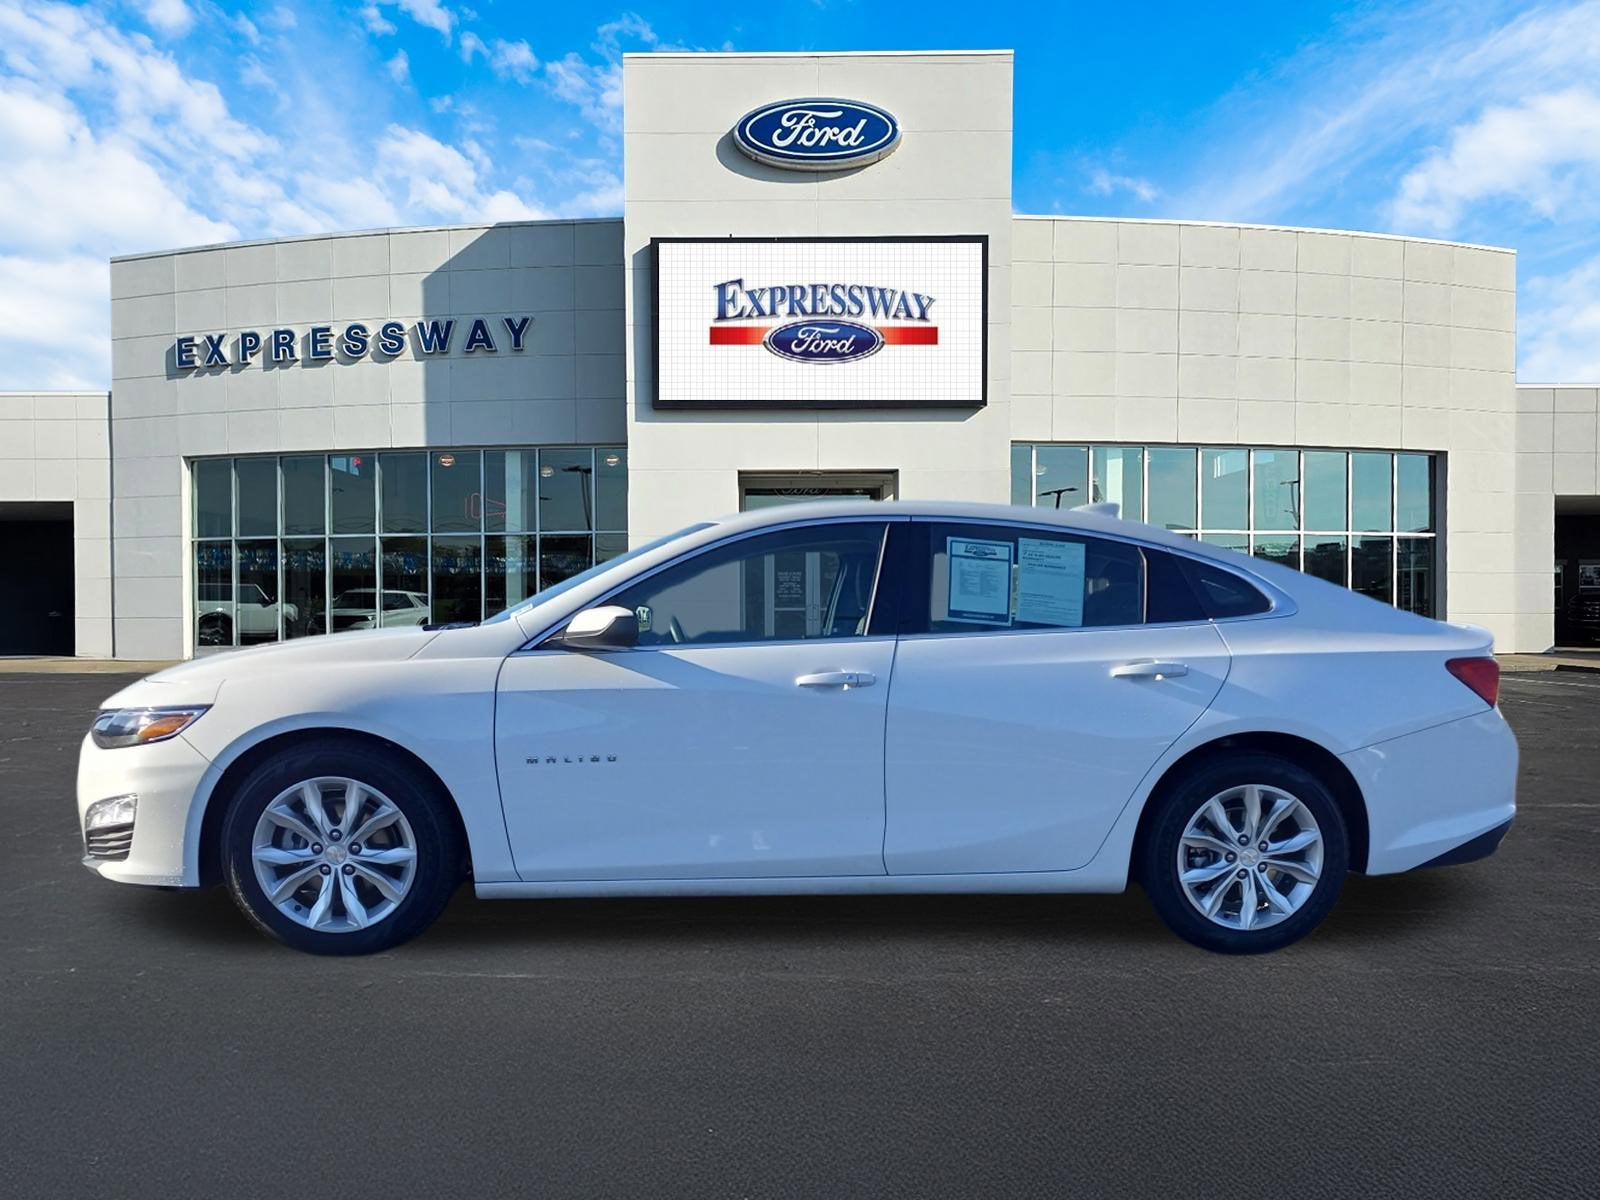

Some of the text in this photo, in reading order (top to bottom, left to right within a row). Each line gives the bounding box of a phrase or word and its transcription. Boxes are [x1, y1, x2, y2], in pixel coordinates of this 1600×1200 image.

[772, 110, 868, 147] Ford
[713, 278, 936, 322] EXPRESSWAY
[175, 316, 534, 369] EXPRESSWAY
[791, 326, 855, 354] Ford
